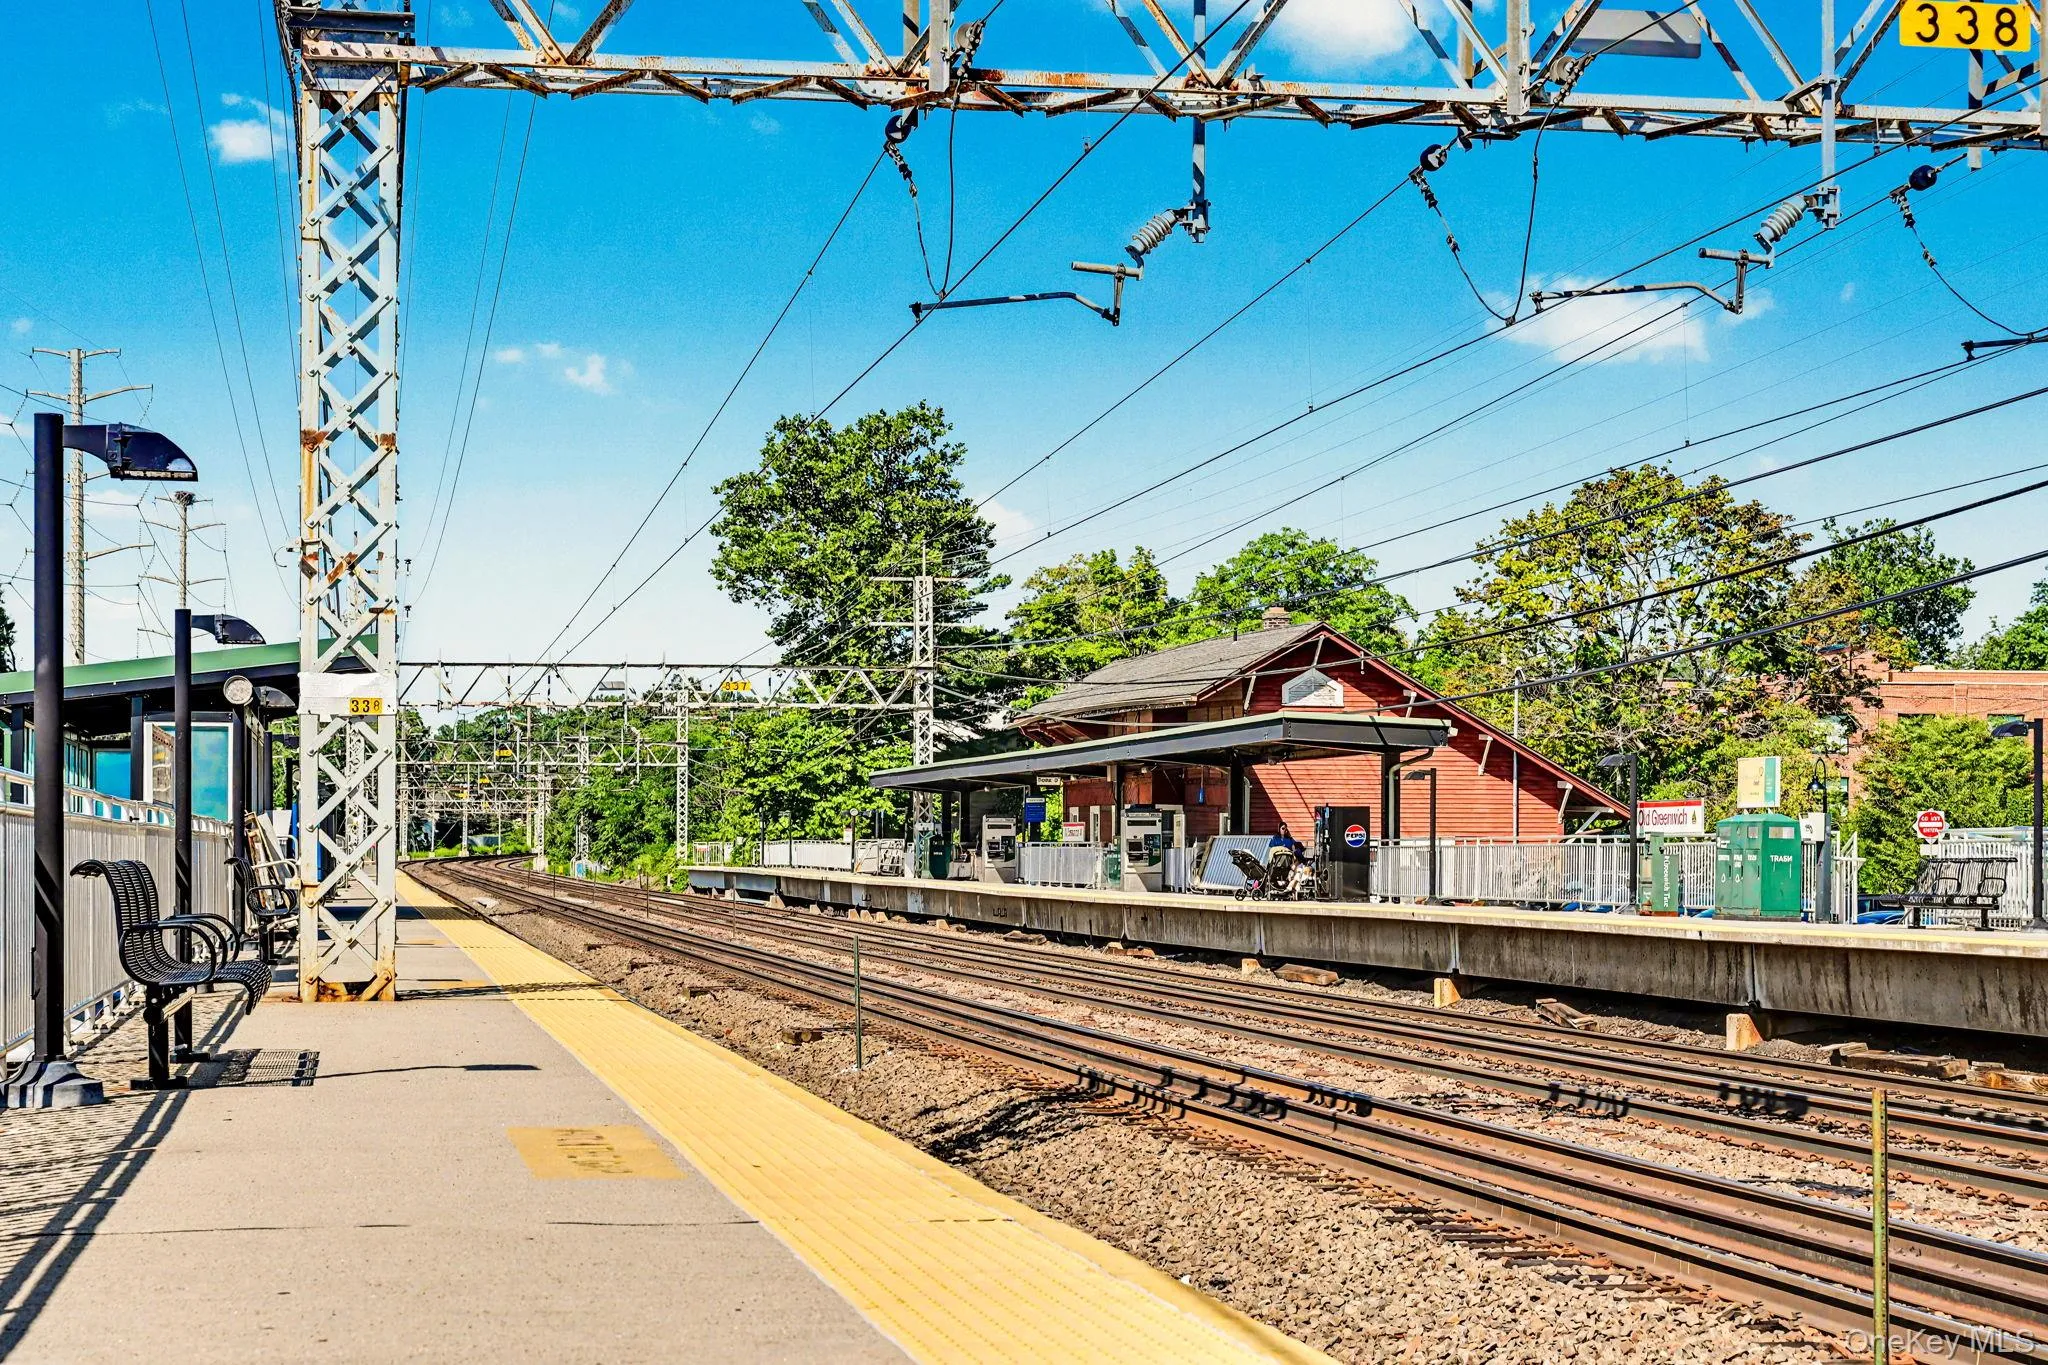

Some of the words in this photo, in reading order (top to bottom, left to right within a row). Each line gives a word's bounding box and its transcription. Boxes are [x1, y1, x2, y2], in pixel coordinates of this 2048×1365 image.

[1915, 3, 2018, 47] 338
[351, 699, 380, 713] 338
[1652, 808, 1687, 826] Greenwich
